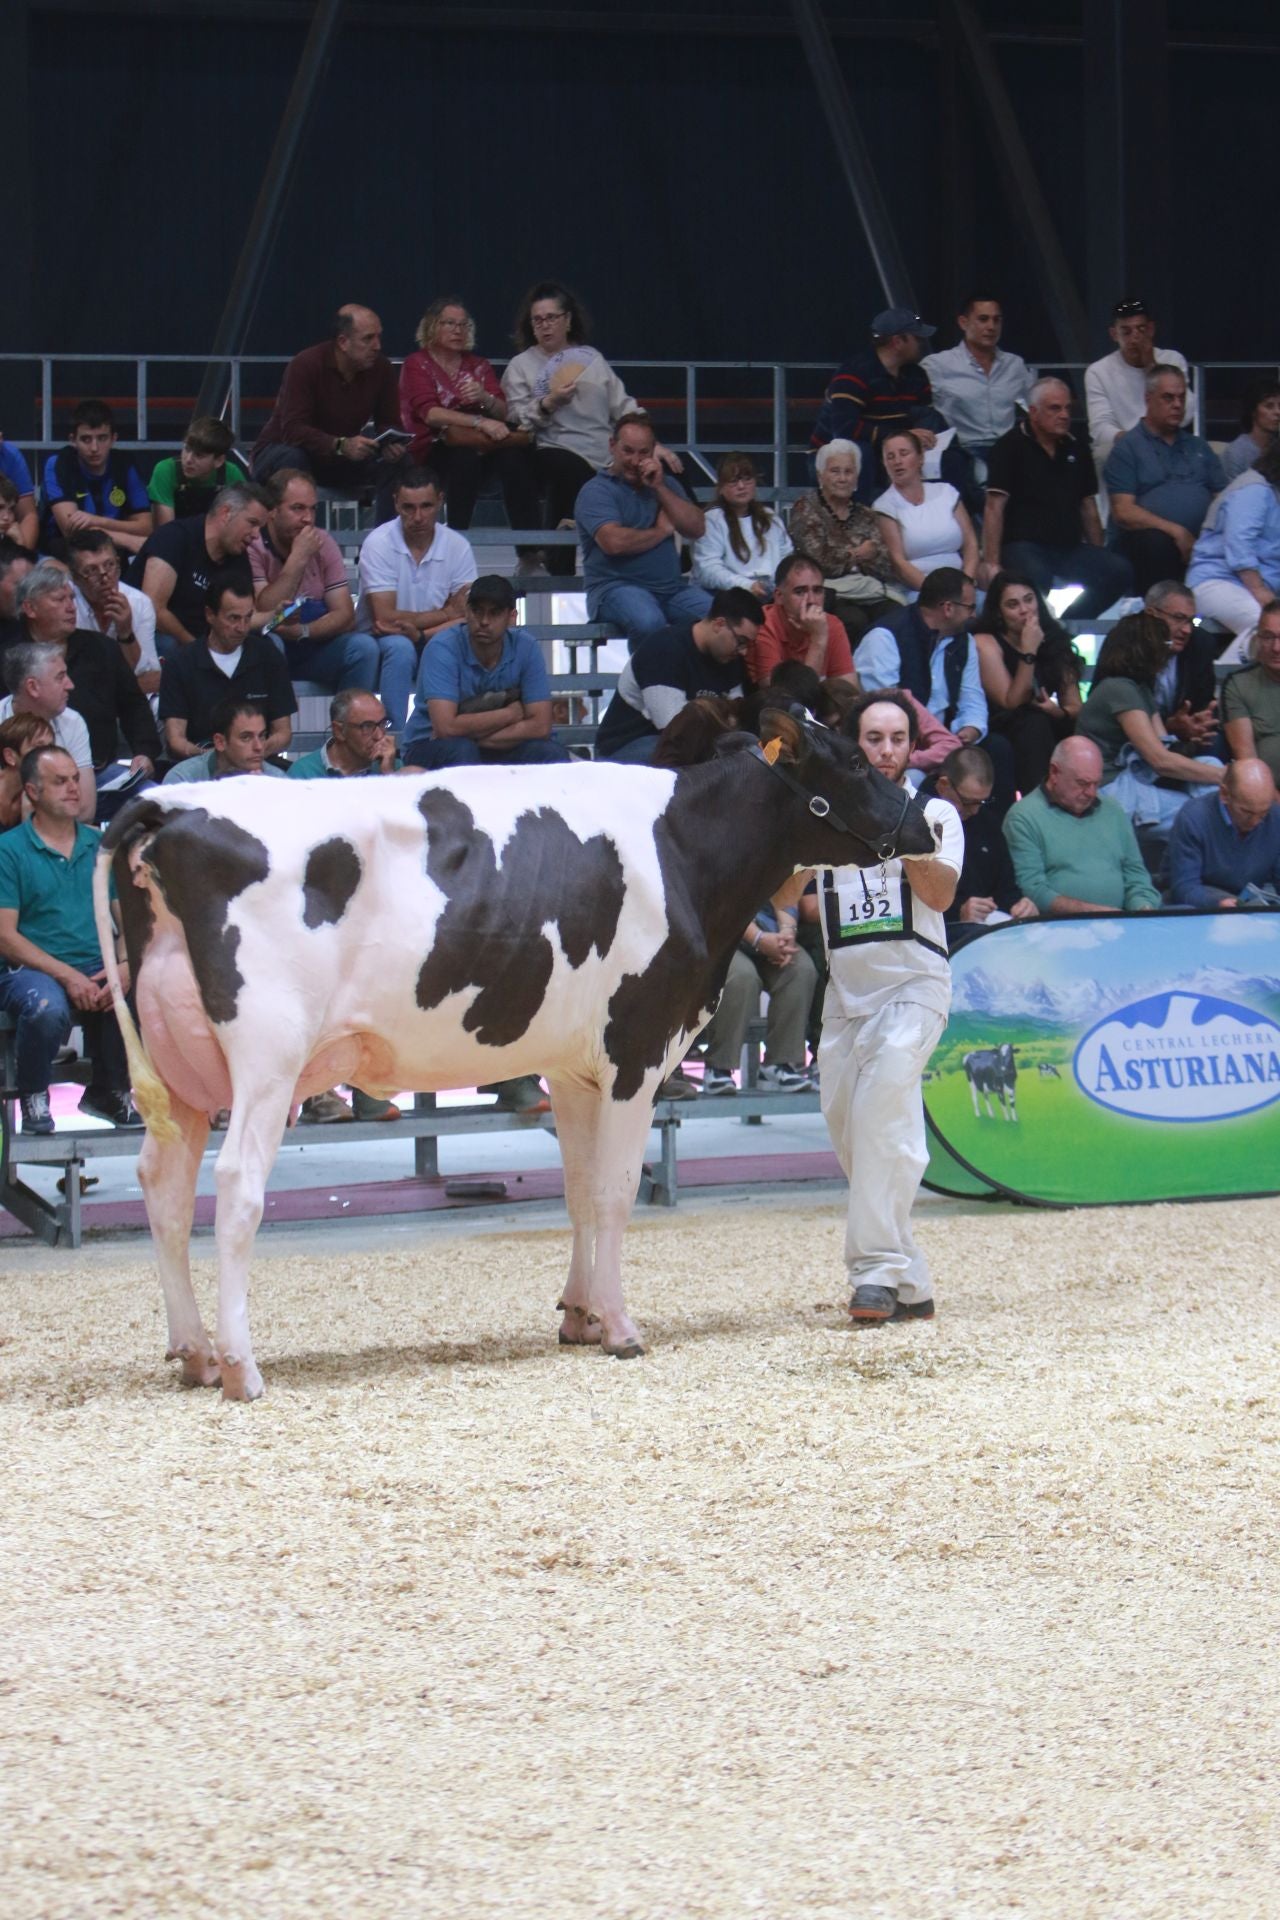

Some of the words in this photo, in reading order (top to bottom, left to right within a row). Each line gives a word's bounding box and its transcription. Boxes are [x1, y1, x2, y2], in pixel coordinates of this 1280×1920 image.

[849, 900, 892, 921] 192
[1122, 1036, 1195, 1052] CENTRAL
[1201, 1032, 1274, 1048] LECHERA
